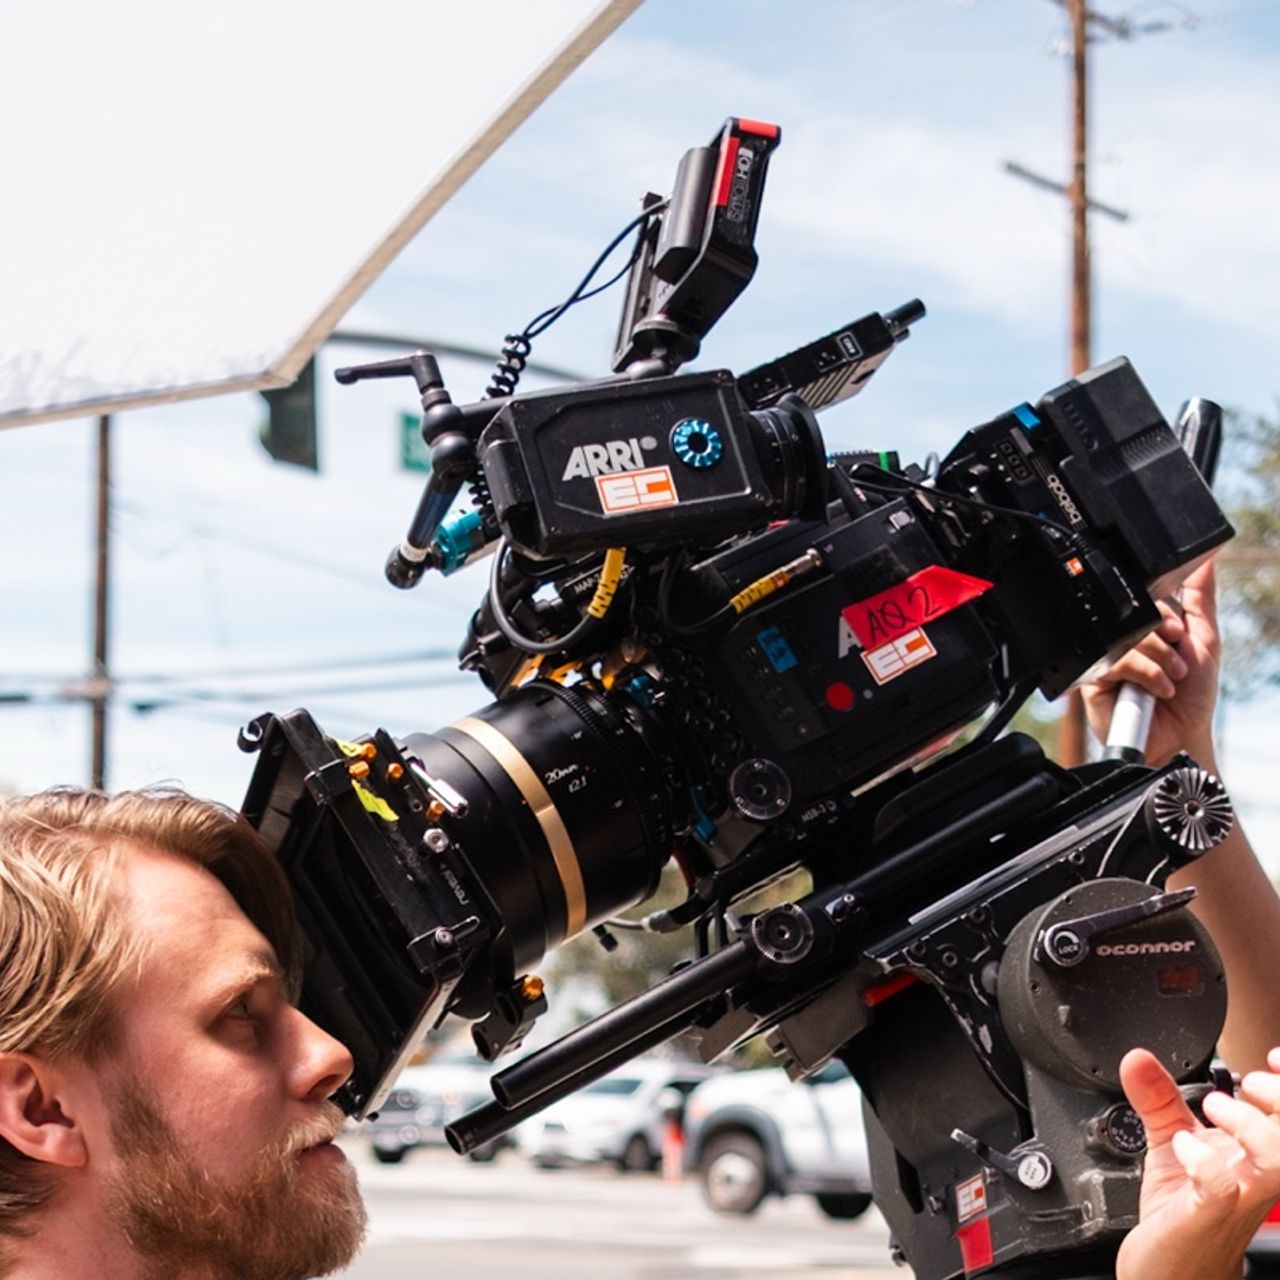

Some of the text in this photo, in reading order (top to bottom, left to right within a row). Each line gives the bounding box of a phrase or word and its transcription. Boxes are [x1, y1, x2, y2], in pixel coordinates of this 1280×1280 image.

[562, 438, 645, 481] ARRI
[1047, 474, 1083, 525] bebob
[1059, 944, 1080, 956] LOCK
[1096, 940, 1197, 957] oconnor
